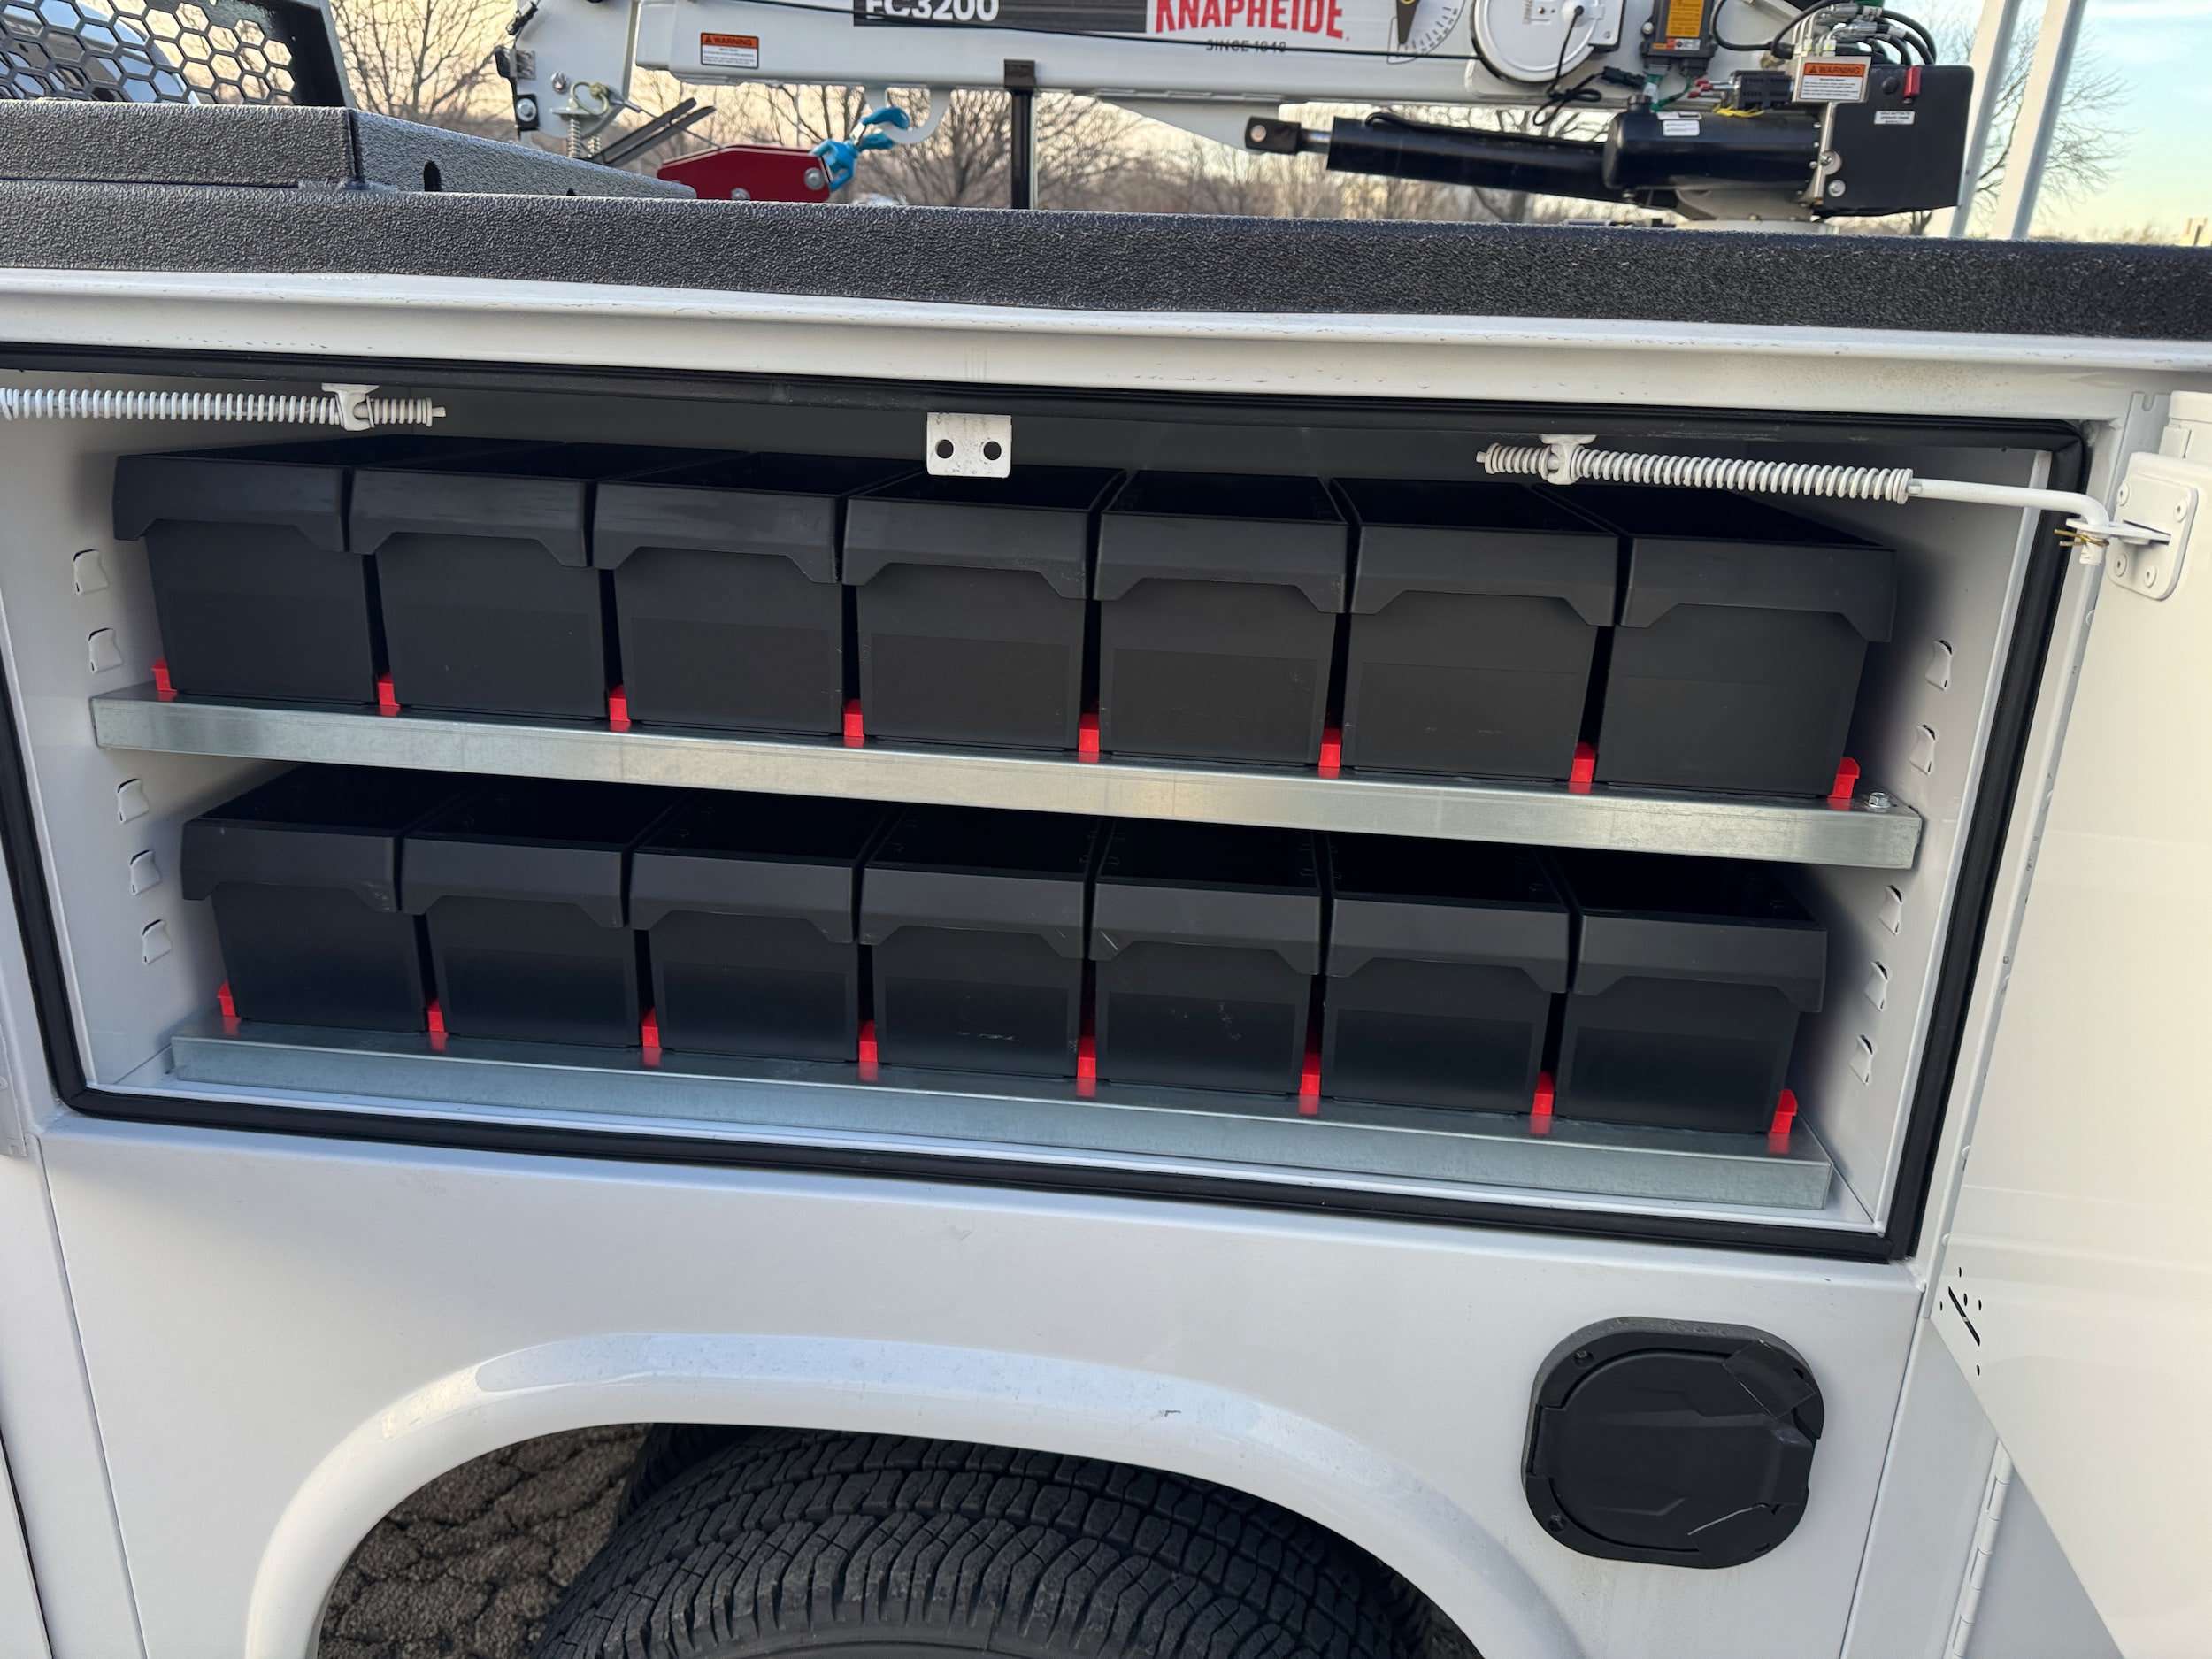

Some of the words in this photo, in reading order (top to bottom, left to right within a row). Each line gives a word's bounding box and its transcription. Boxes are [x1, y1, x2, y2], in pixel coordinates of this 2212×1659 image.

[1155, 0, 1344, 39] KNAPHEIDE
[713, 36, 752, 45] WARNING
[1818, 65, 1861, 74] WARNING
